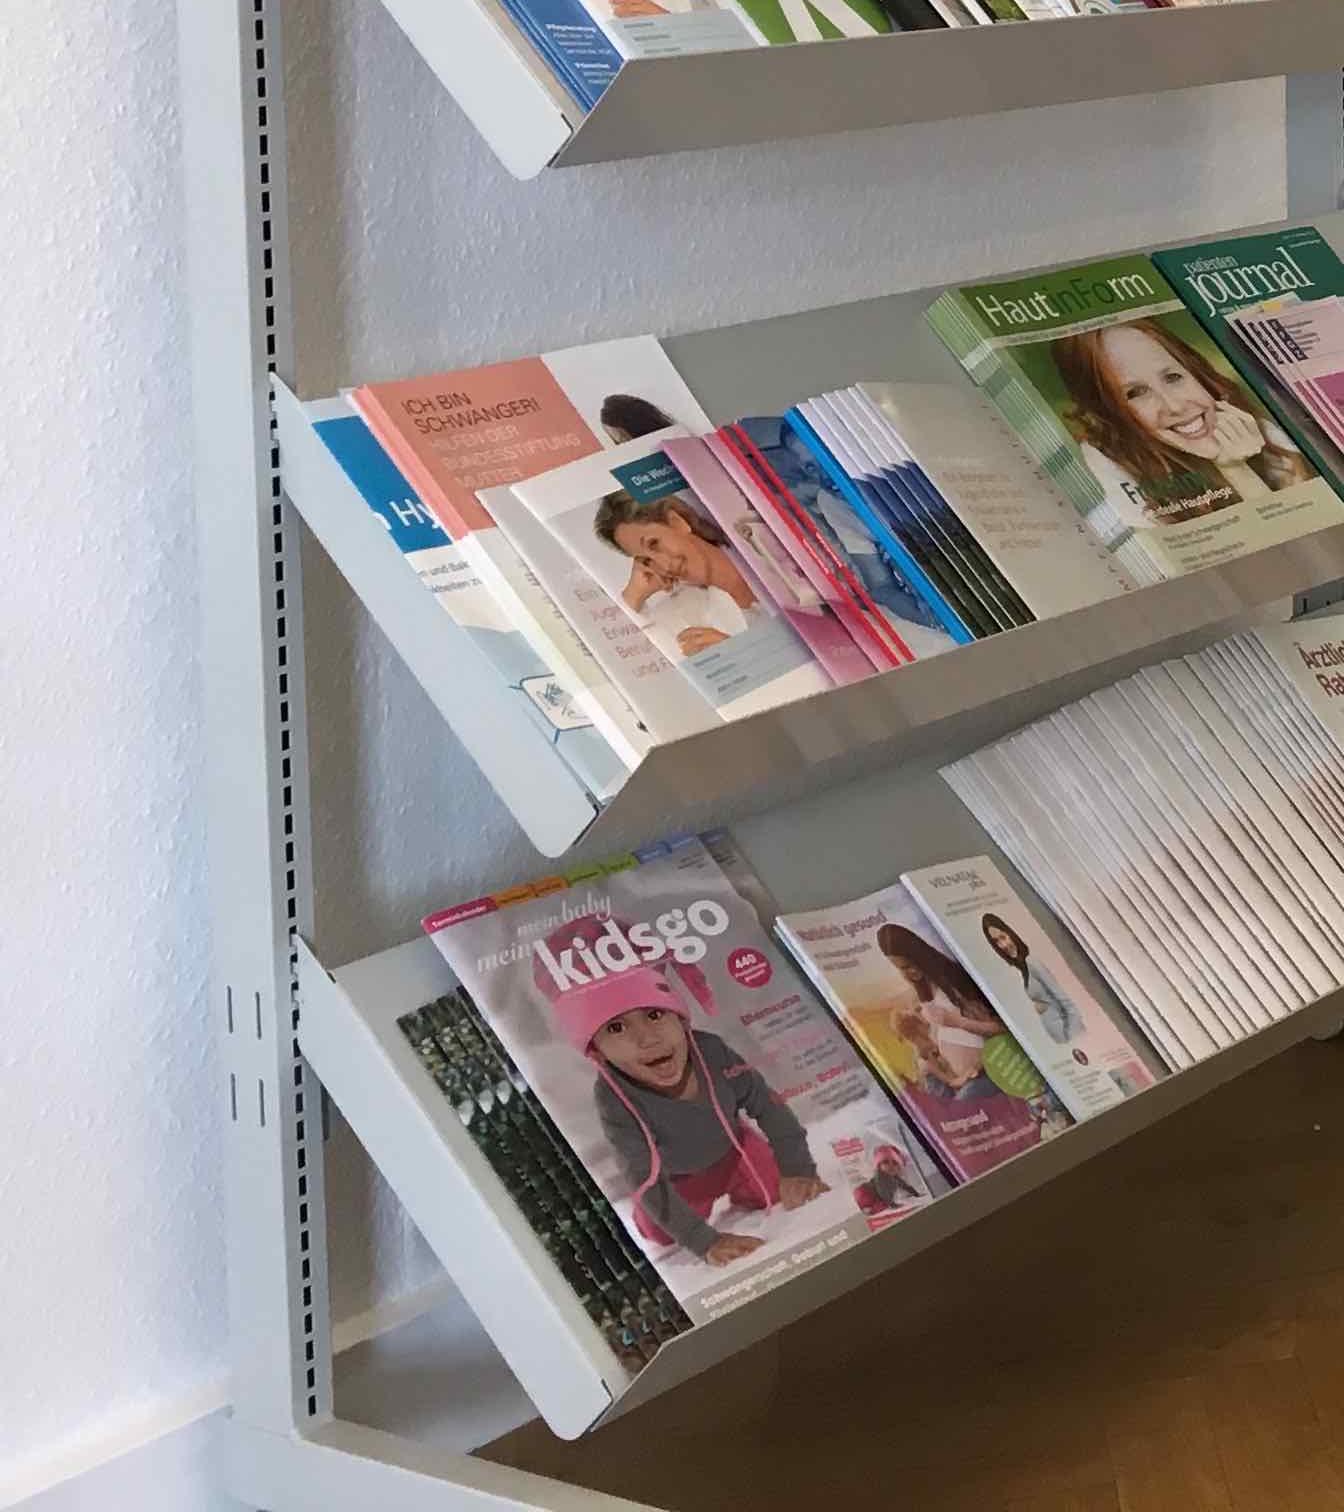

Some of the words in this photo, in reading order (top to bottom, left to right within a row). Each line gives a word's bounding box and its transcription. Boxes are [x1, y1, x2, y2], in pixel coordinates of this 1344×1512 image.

[1184, 254, 1239, 275] patienten
[1184, 247, 1315, 317] journal
[401, 399, 435, 416] ICH
[436, 392, 472, 410] BIN
[414, 396, 542, 434] SCHWANGER!
[1182, 486, 1234, 509] Hautpflege
[560, 892, 613, 924] baby
[476, 939, 537, 974] mein
[533, 900, 730, 992] kidsgo
